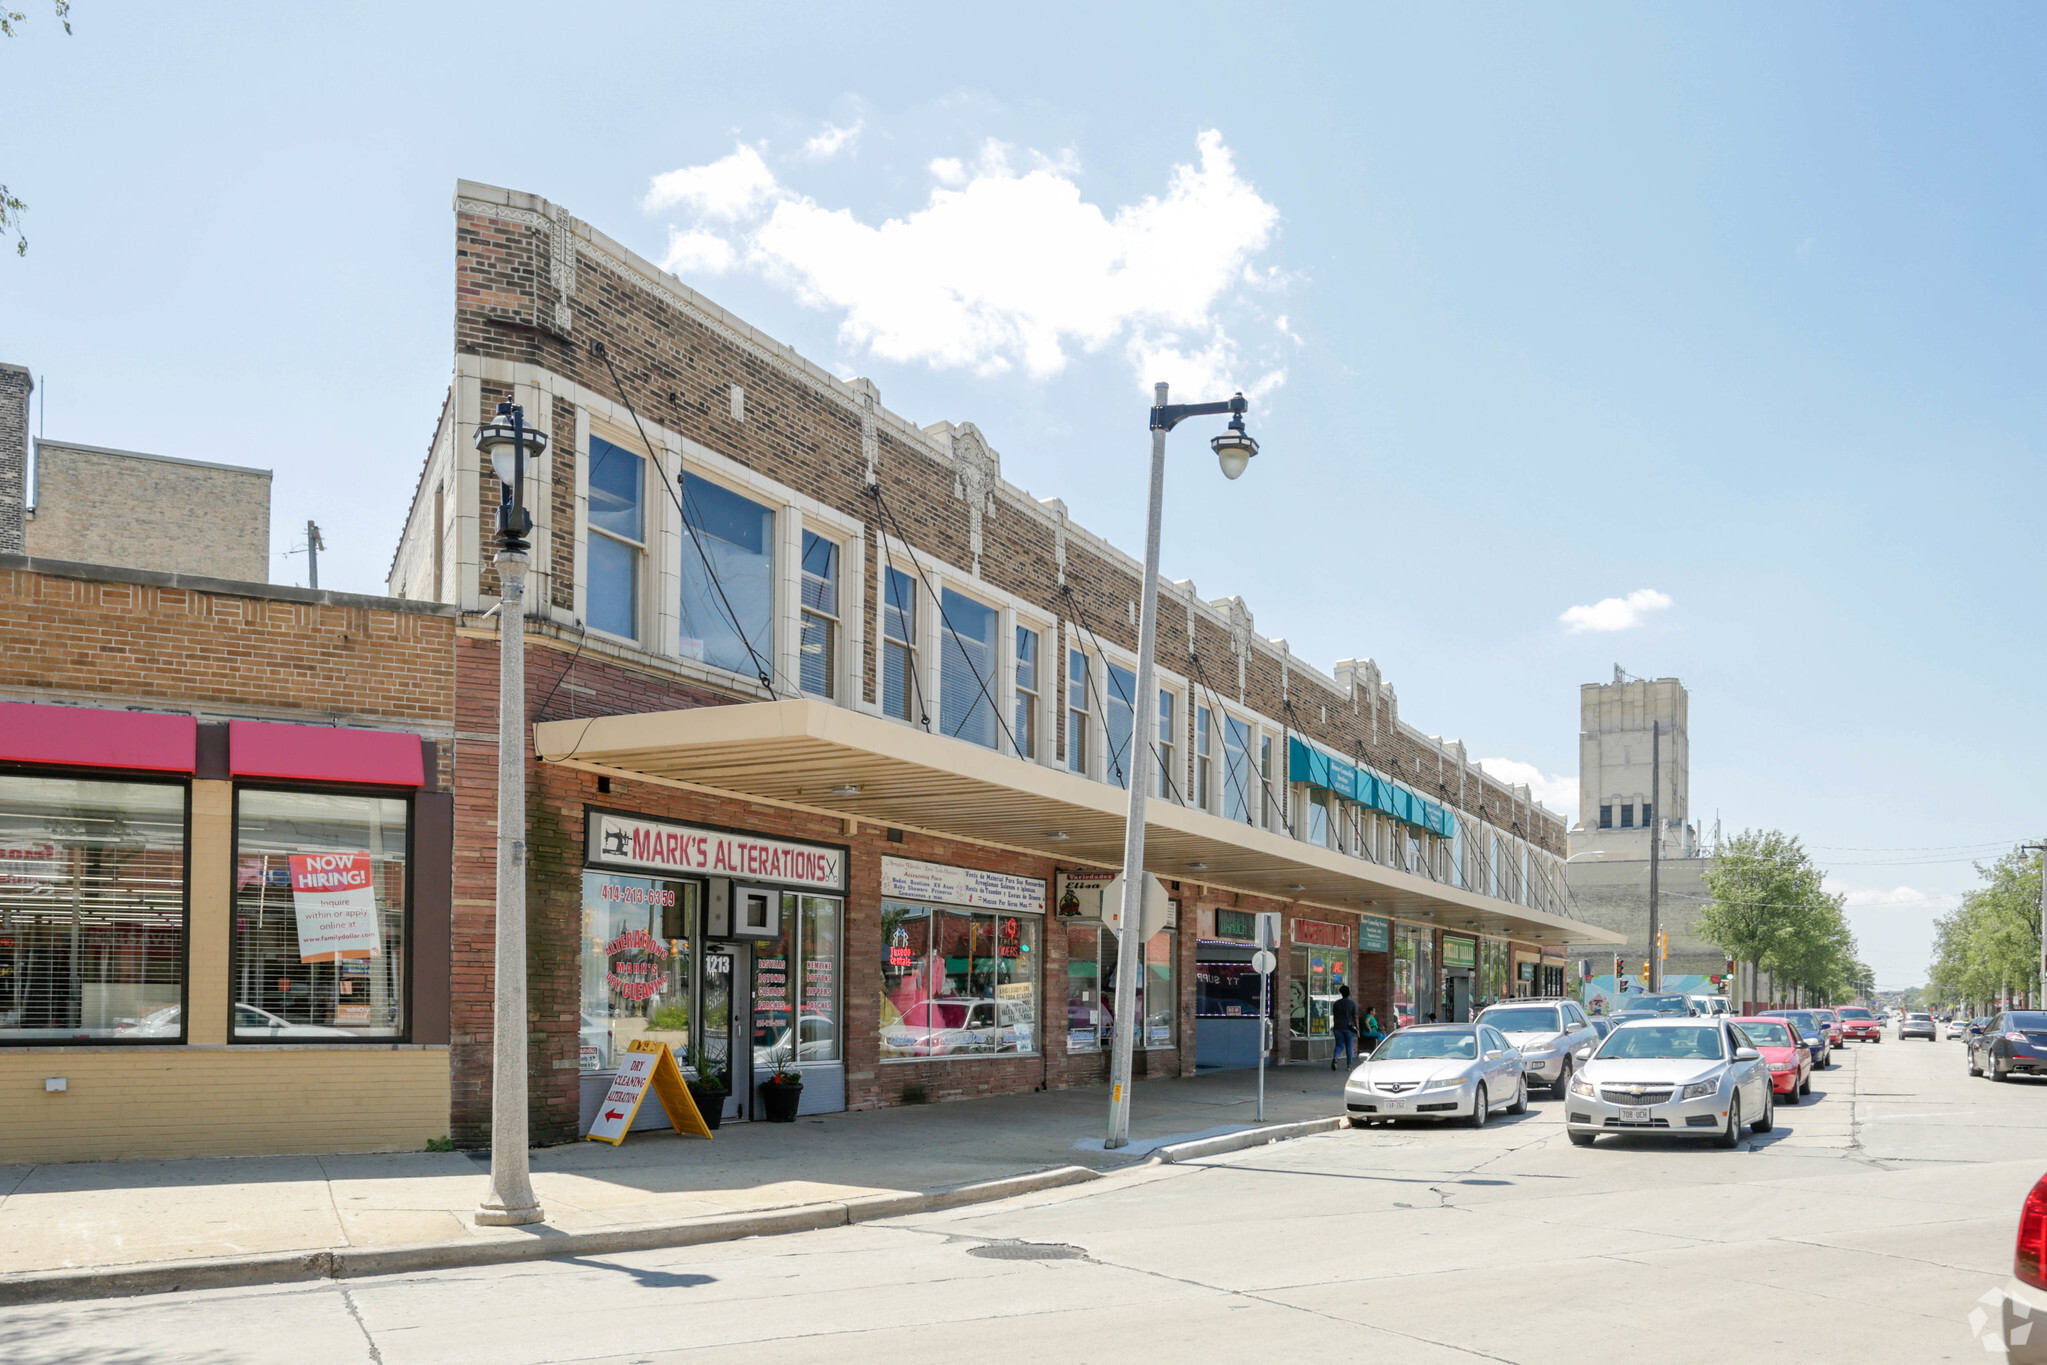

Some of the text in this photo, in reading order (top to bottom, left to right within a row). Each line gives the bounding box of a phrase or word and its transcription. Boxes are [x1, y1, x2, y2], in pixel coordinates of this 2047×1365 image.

[632, 826, 826, 882] MARK'S ALTERATIONS
[306, 855, 354, 871] NOW
[298, 870, 366, 888] HIRING!
[601, 884, 675, 907] 414-213-6359
[320, 899, 350, 908] Inquire
[305, 911, 331, 920] within
[345, 909, 368, 918] apply
[320, 922, 346, 931] online
[303, 932, 375, 943] www.familydollar.com
[605, 929, 669, 960] ALTERATIONS
[616, 962, 658, 974] MARK'S
[705, 955, 730, 974] 1213
[806, 960, 832, 971] HEMLINE
[758, 973, 786, 983] BOTONES
[605, 971, 668, 1000] DRY CLEANING
[758, 986, 785, 996] CIERRES
[806, 986, 832, 996] ZIPPERS
[758, 1000, 785, 1010] PARCHES
[806, 1000, 832, 1010] PATCHES
[630, 1060, 645, 1072] DRY
[614, 1075, 646, 1088] CLEANING
[606, 1090, 640, 1104] ALTERATIONS
